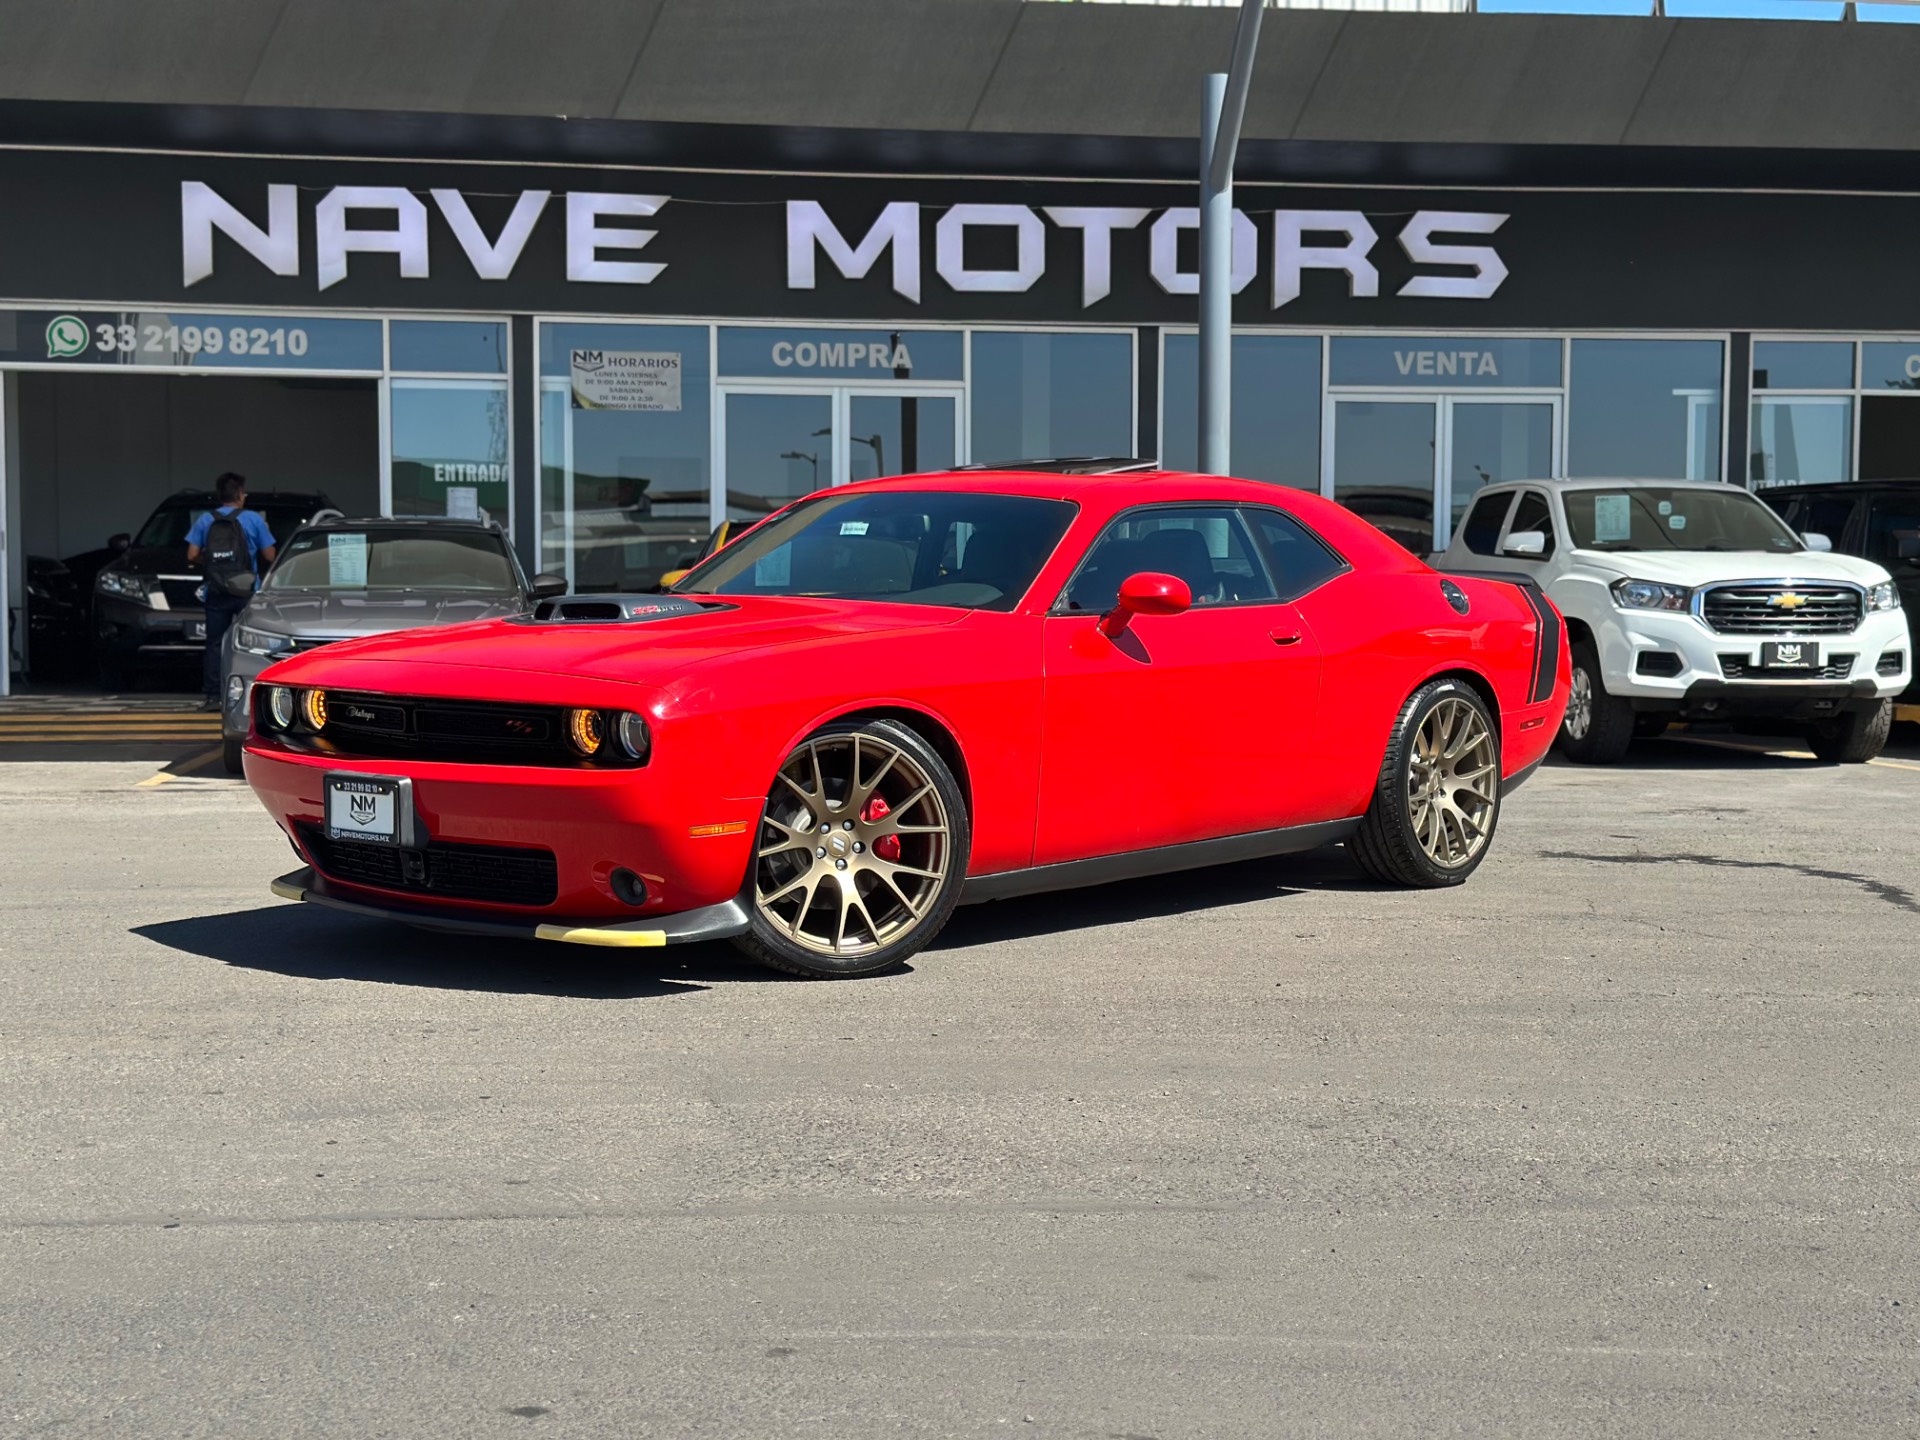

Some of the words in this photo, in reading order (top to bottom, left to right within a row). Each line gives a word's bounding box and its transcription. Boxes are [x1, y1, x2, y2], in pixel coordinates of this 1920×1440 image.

[181, 181, 672, 291] NAVE
[786, 200, 1511, 310] MOTORS
[95, 323, 137, 352] 33
[143, 325, 224, 354] 2199
[229, 327, 309, 356] 8210
[573, 351, 604, 364] NM
[608, 357, 679, 369] HORARIOS
[771, 341, 914, 370] COMPRA
[1393, 351, 1499, 377] VENTA
[213, 550, 234, 558] SPORT
[1777, 644, 1801, 657] NM
[344, 782, 350, 790] 33
[351, 794, 376, 813] NM
